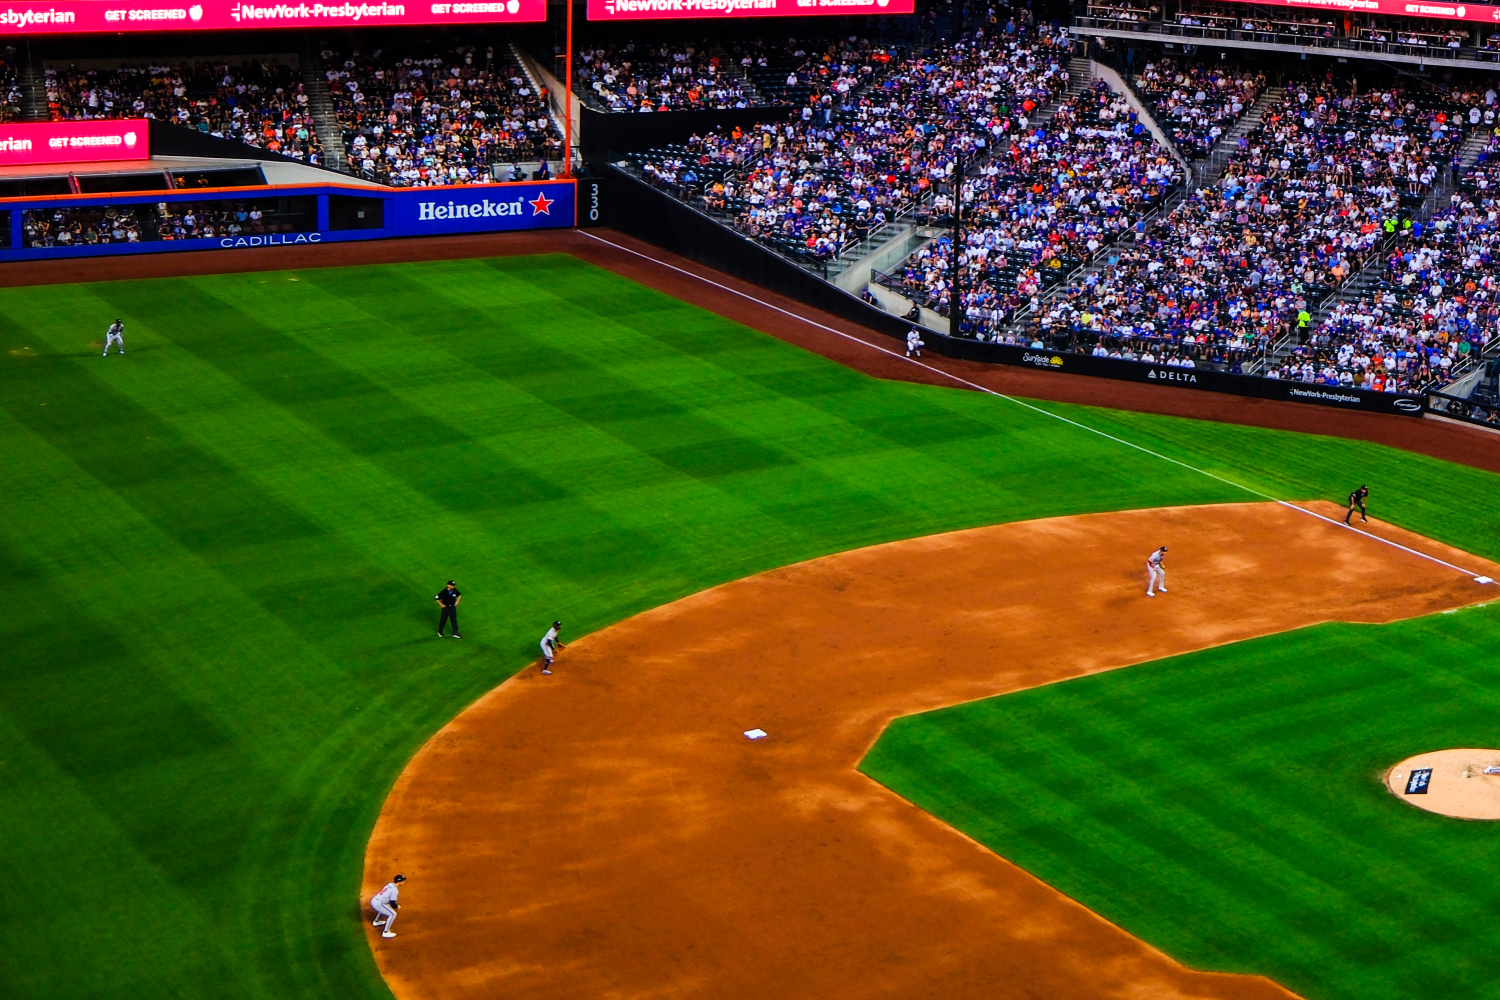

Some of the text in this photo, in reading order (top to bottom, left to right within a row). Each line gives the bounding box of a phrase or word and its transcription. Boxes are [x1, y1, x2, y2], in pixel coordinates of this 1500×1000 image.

[242, 2, 404, 20] NewYork-Presbyterian
[431, 3, 504, 13] GET SCREENED
[1406, 4, 1455, 15] GET SCREENED
[0, 9, 75, 27] sbyterian
[105, 9, 186, 20] GET SCREENED
[49, 136, 122, 147] GET SCREENED
[419, 199, 522, 220] Heineken
[221, 233, 320, 247] CADILLAC
[1160, 371, 1196, 382] DELTA
[1294, 389, 1360, 402] NewYork-Presbyterian
